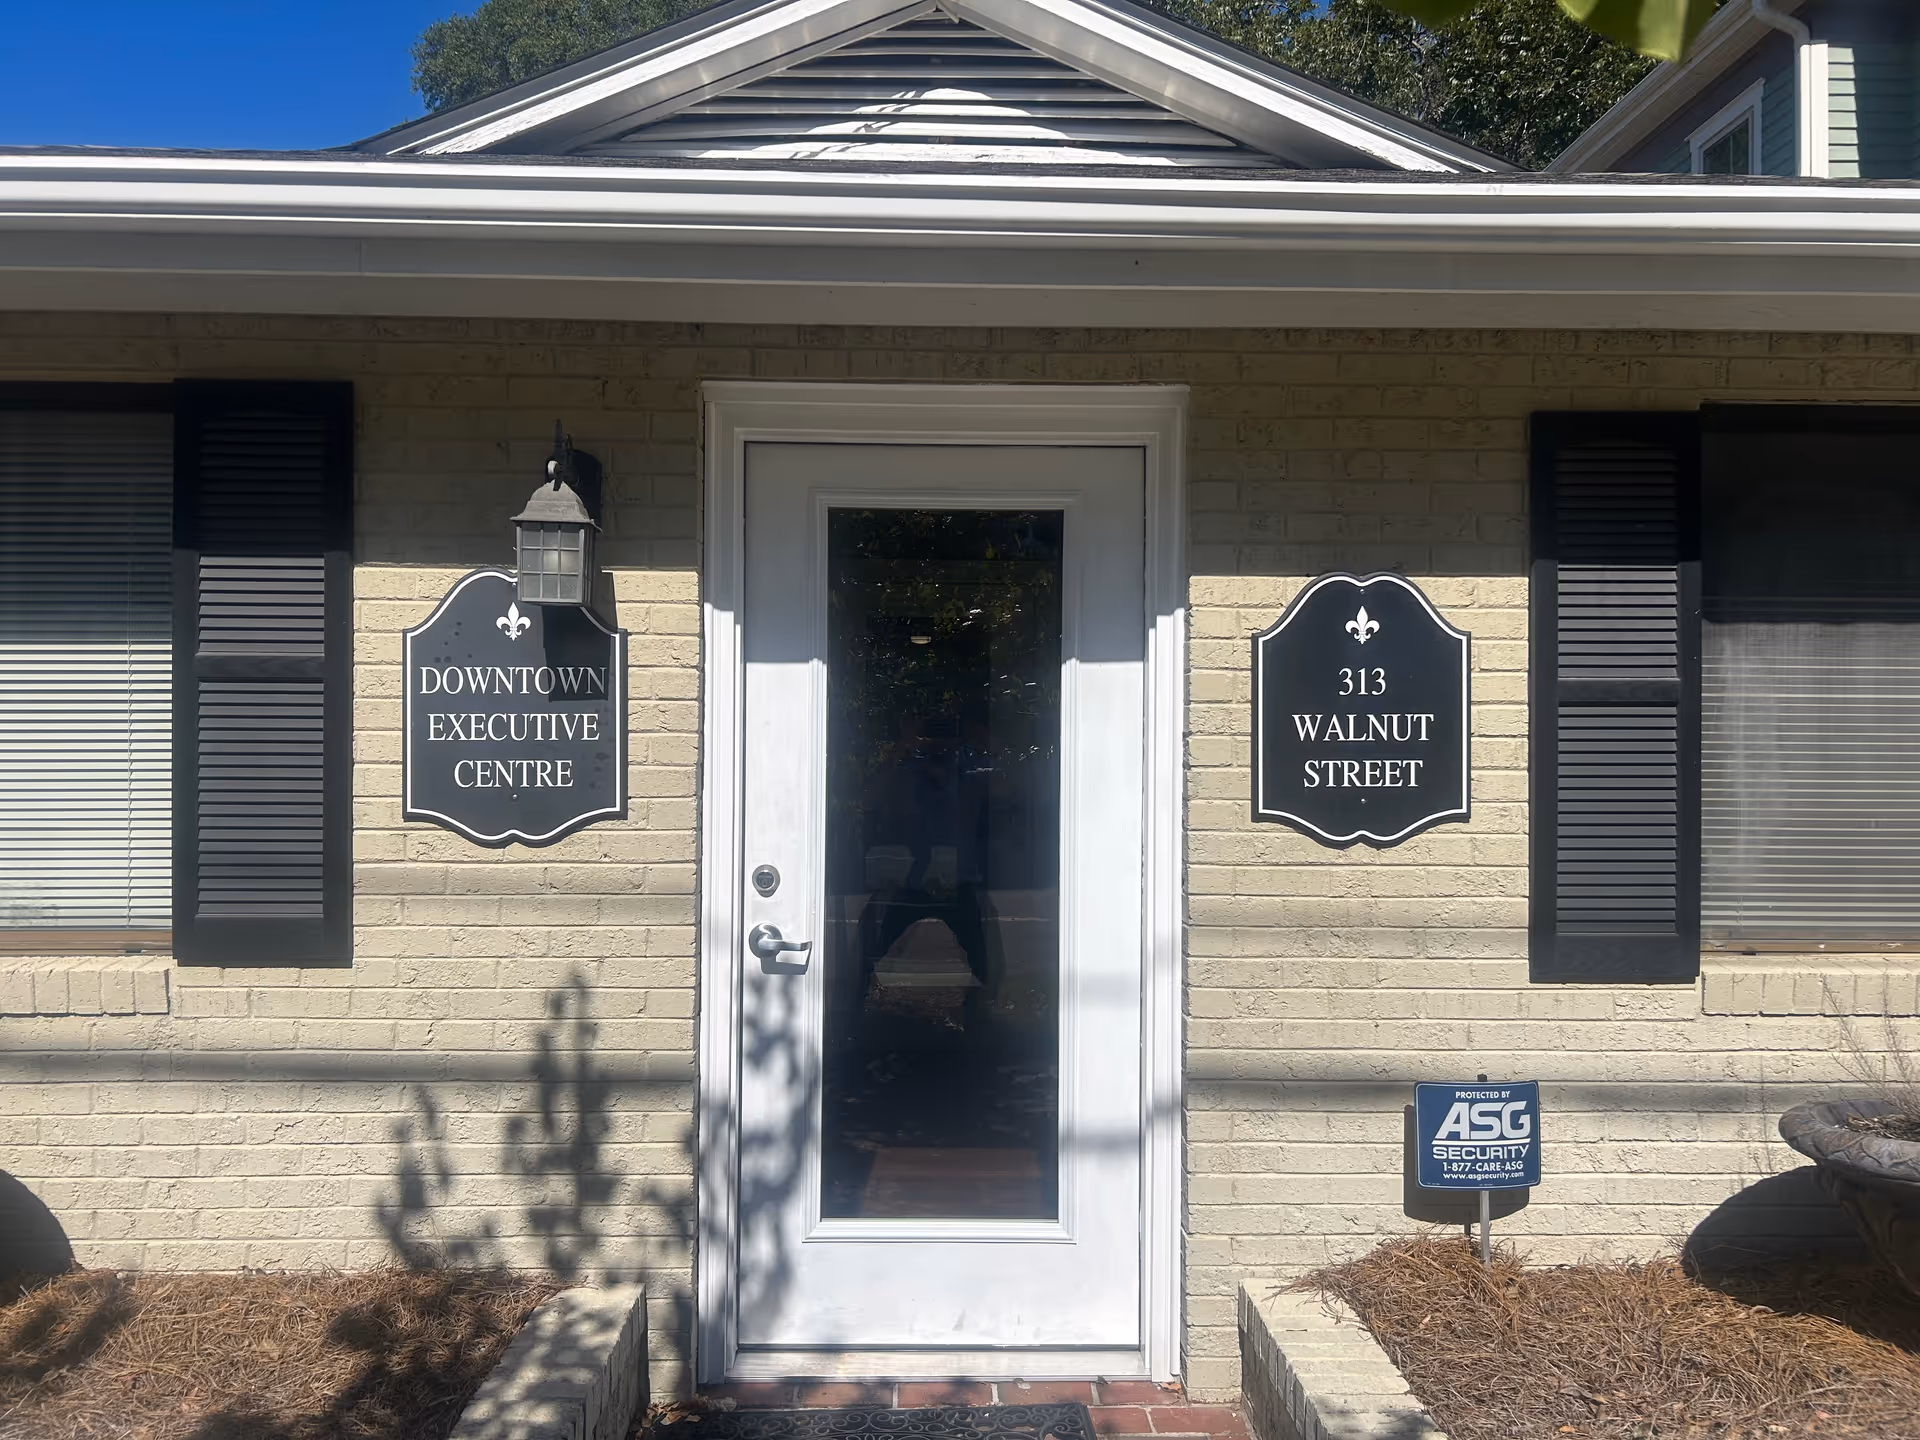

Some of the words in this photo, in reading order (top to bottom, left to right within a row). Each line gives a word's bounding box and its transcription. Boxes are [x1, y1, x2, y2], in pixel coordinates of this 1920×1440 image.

[420, 666, 607, 694] DOWNTOWN
[1338, 667, 1387, 696] 313
[427, 713, 600, 741] EXECUTIVE
[1291, 713, 1434, 742] WALNUT
[454, 760, 574, 788] CENTRE
[1303, 759, 1423, 788] STREET
[1455, 1091, 1500, 1099] PROTECTED
[1501, 1090, 1511, 1098] BY
[1434, 1100, 1531, 1140] ASG
[1432, 1144, 1530, 1160] SECURITY
[1442, 1161, 1524, 1172] 1-877-CARE-ASG
[1442, 1171, 1524, 1181] www.asgsecurity.com
